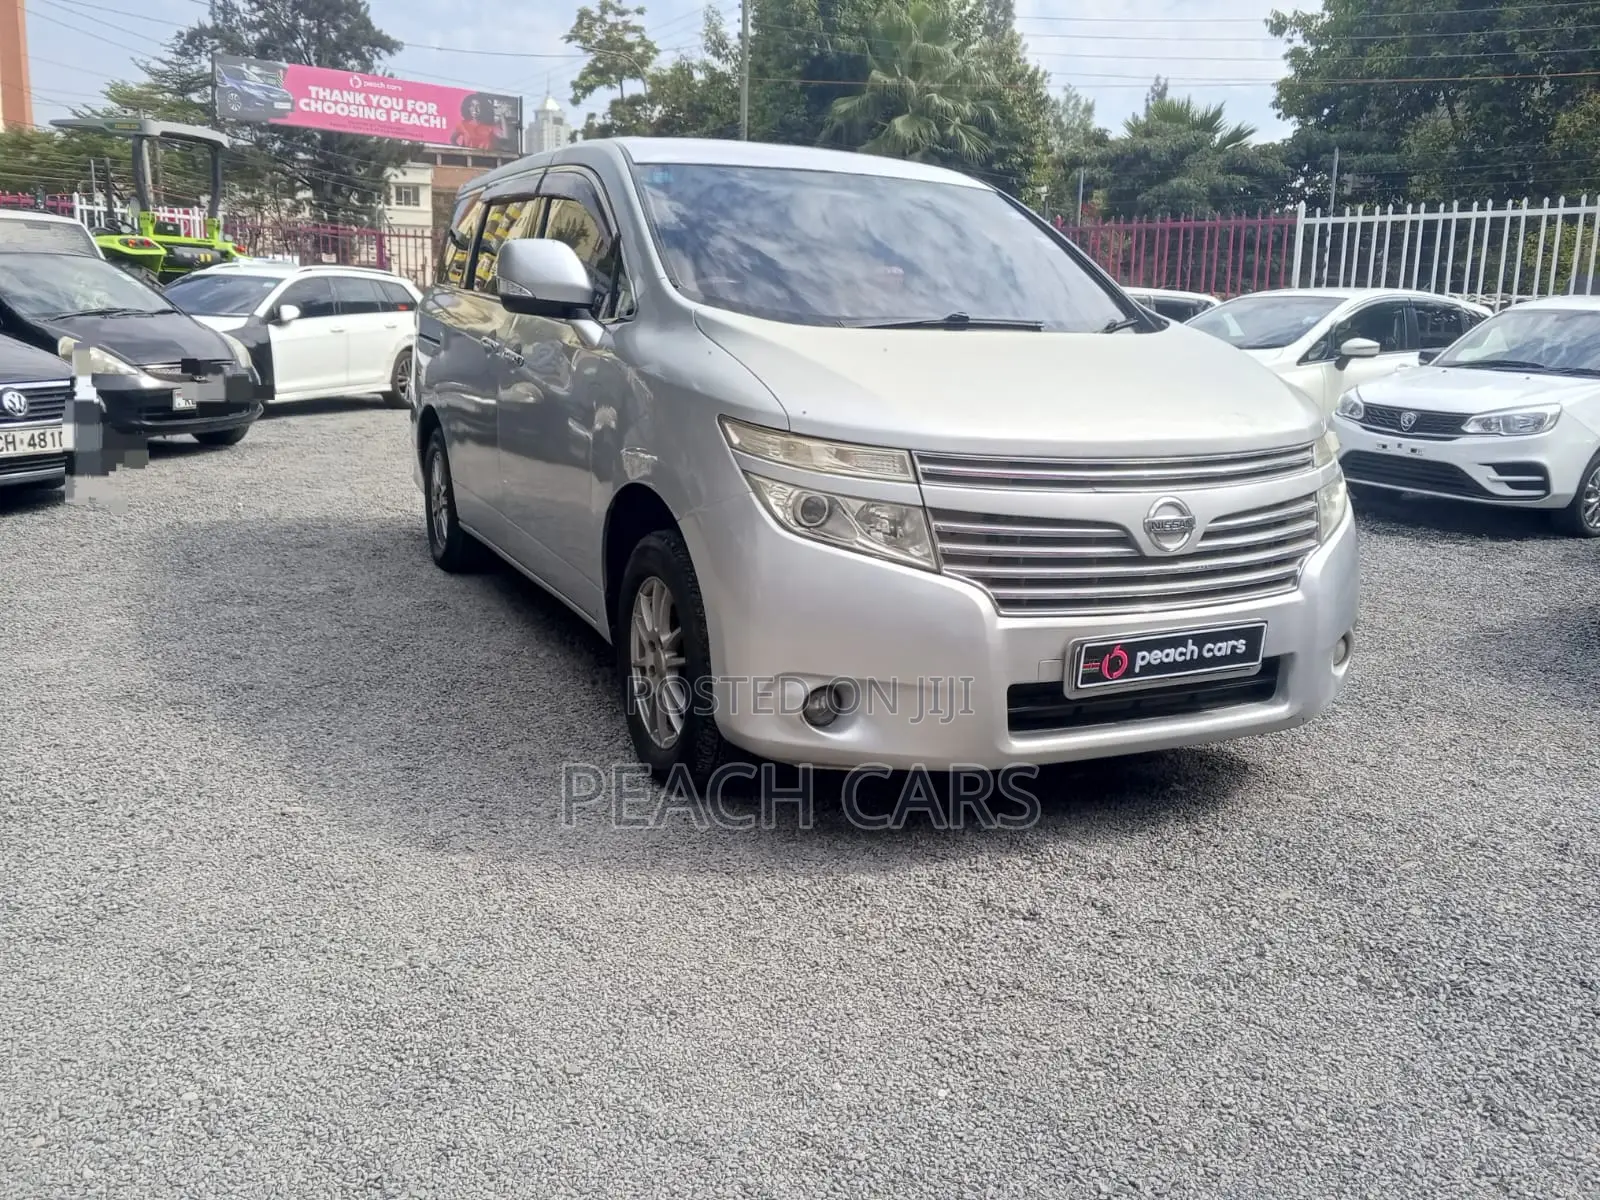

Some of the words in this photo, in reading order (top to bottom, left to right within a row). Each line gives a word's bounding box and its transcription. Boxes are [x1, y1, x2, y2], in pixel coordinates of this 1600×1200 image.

[363, 80, 386, 89] peach
[299, 98, 387, 121] CHOOSING
[390, 110, 448, 129] PEACH!
[308, 85, 367, 106] THANK
[369, 93, 404, 110] YOU
[407, 99, 438, 115] FOR
[1151, 519, 1194, 531] NISSAN
[1134, 639, 1198, 672] peach
[1202, 638, 1247, 657] cars
